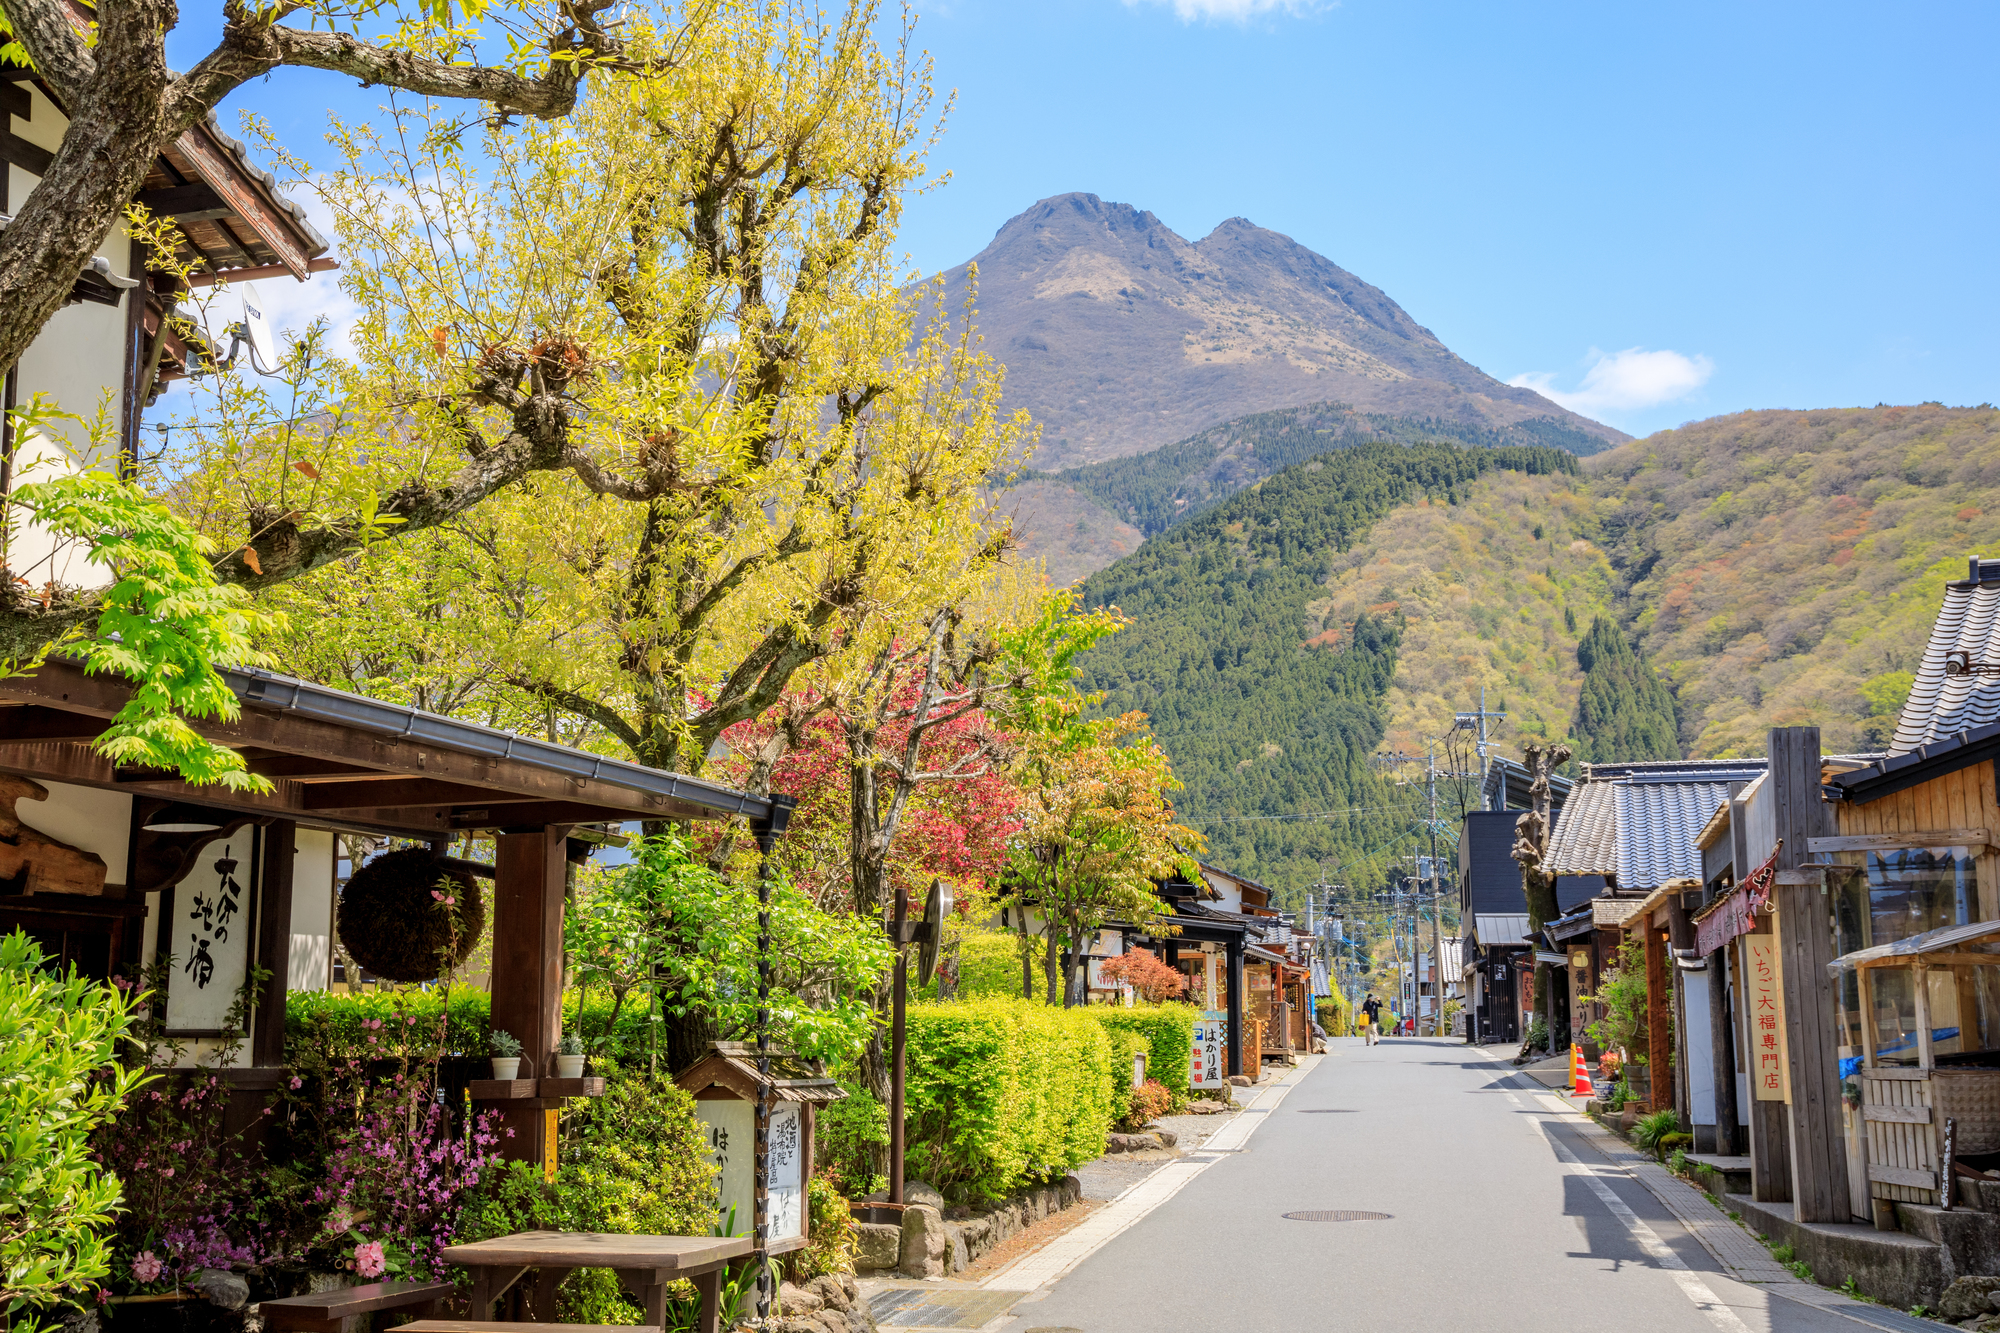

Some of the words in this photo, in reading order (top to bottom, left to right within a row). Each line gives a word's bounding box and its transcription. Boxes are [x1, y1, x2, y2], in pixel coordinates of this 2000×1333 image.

[213, 844, 241, 944] 大分の
[185, 891, 214, 989] 地酒
[1204, 1028, 1219, 1082] はかり屋
[1753, 945, 1779, 1089] いちご大福専門店
[1193, 1048, 1203, 1083] 駐車場
[713, 1127, 729, 1214] はかり
[776, 1122, 788, 1167] 湯布院
